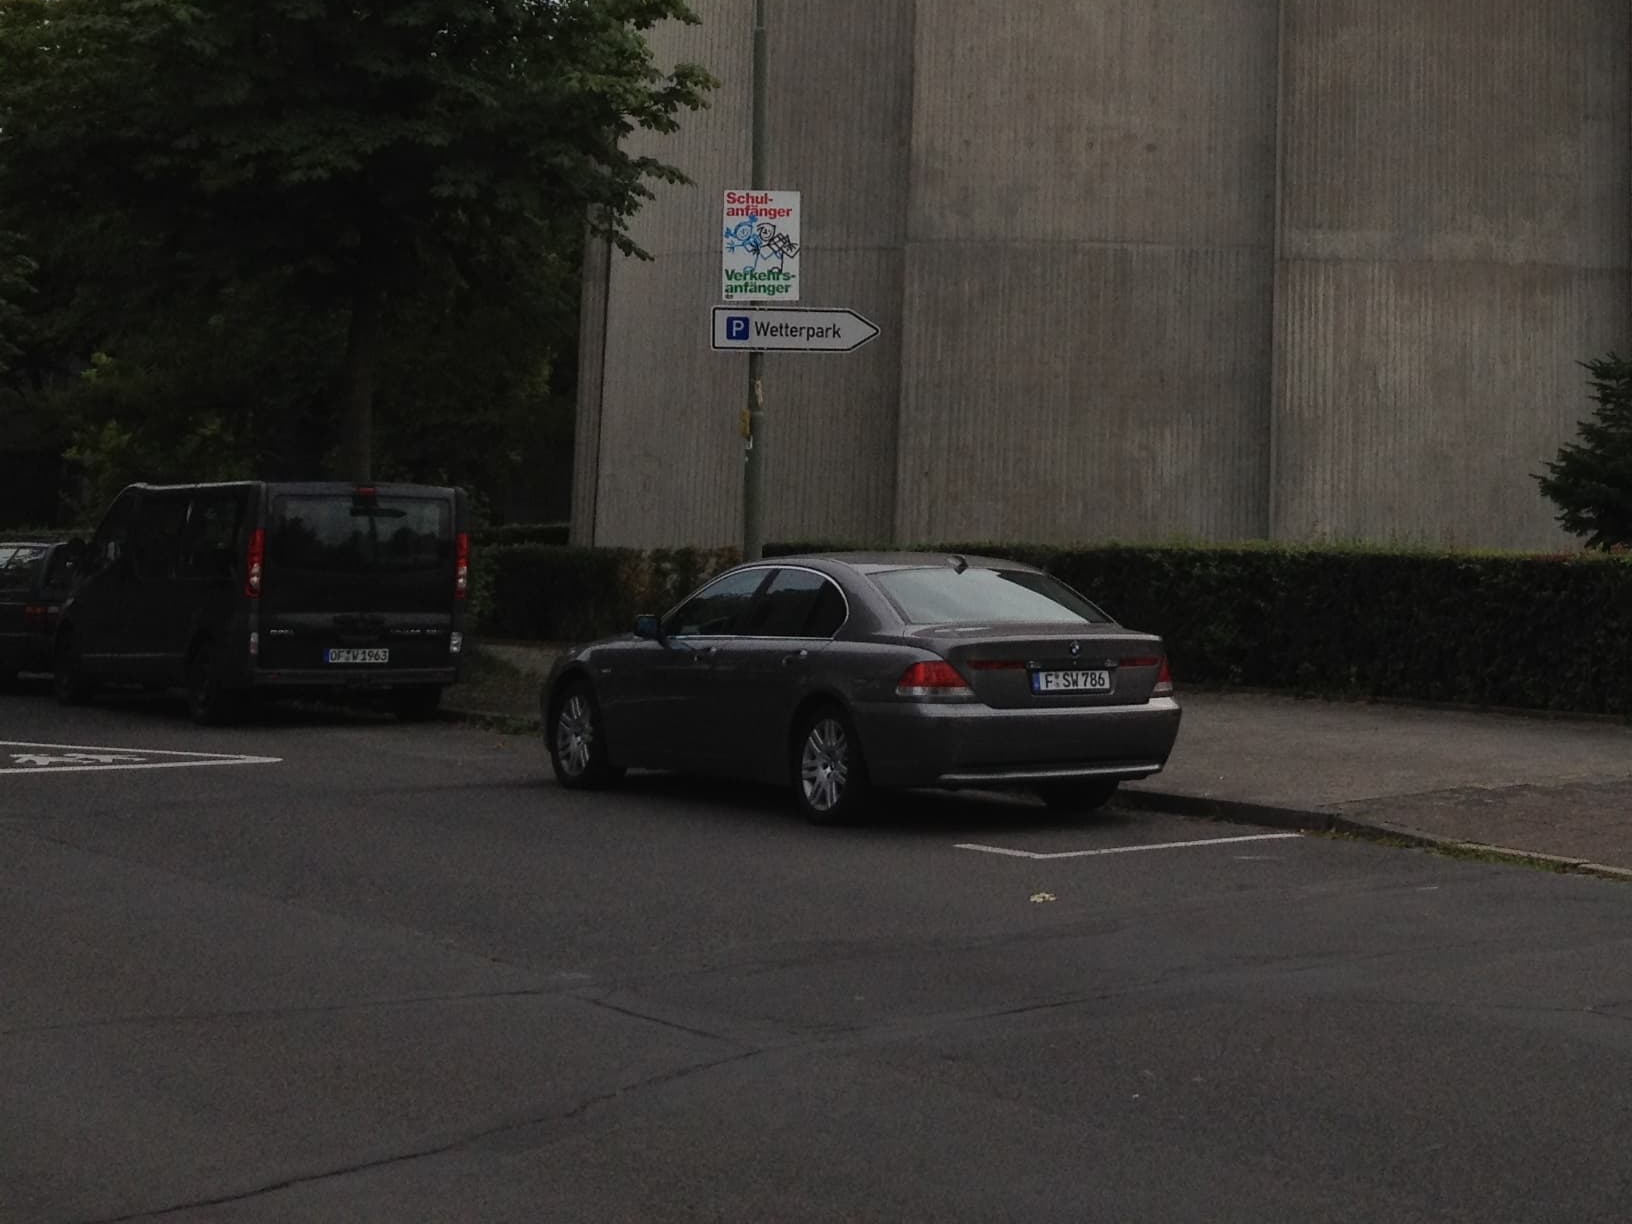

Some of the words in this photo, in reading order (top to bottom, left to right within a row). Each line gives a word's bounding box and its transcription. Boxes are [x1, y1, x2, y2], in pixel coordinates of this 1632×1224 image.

[726, 192, 774, 205] Schul-
[726, 205, 792, 219] anfänger
[724, 268, 796, 281] Verkehrs-
[724, 281, 792, 296] anfänger
[732, 320, 745, 337] P
[755, 321, 841, 341] Wetterpark
